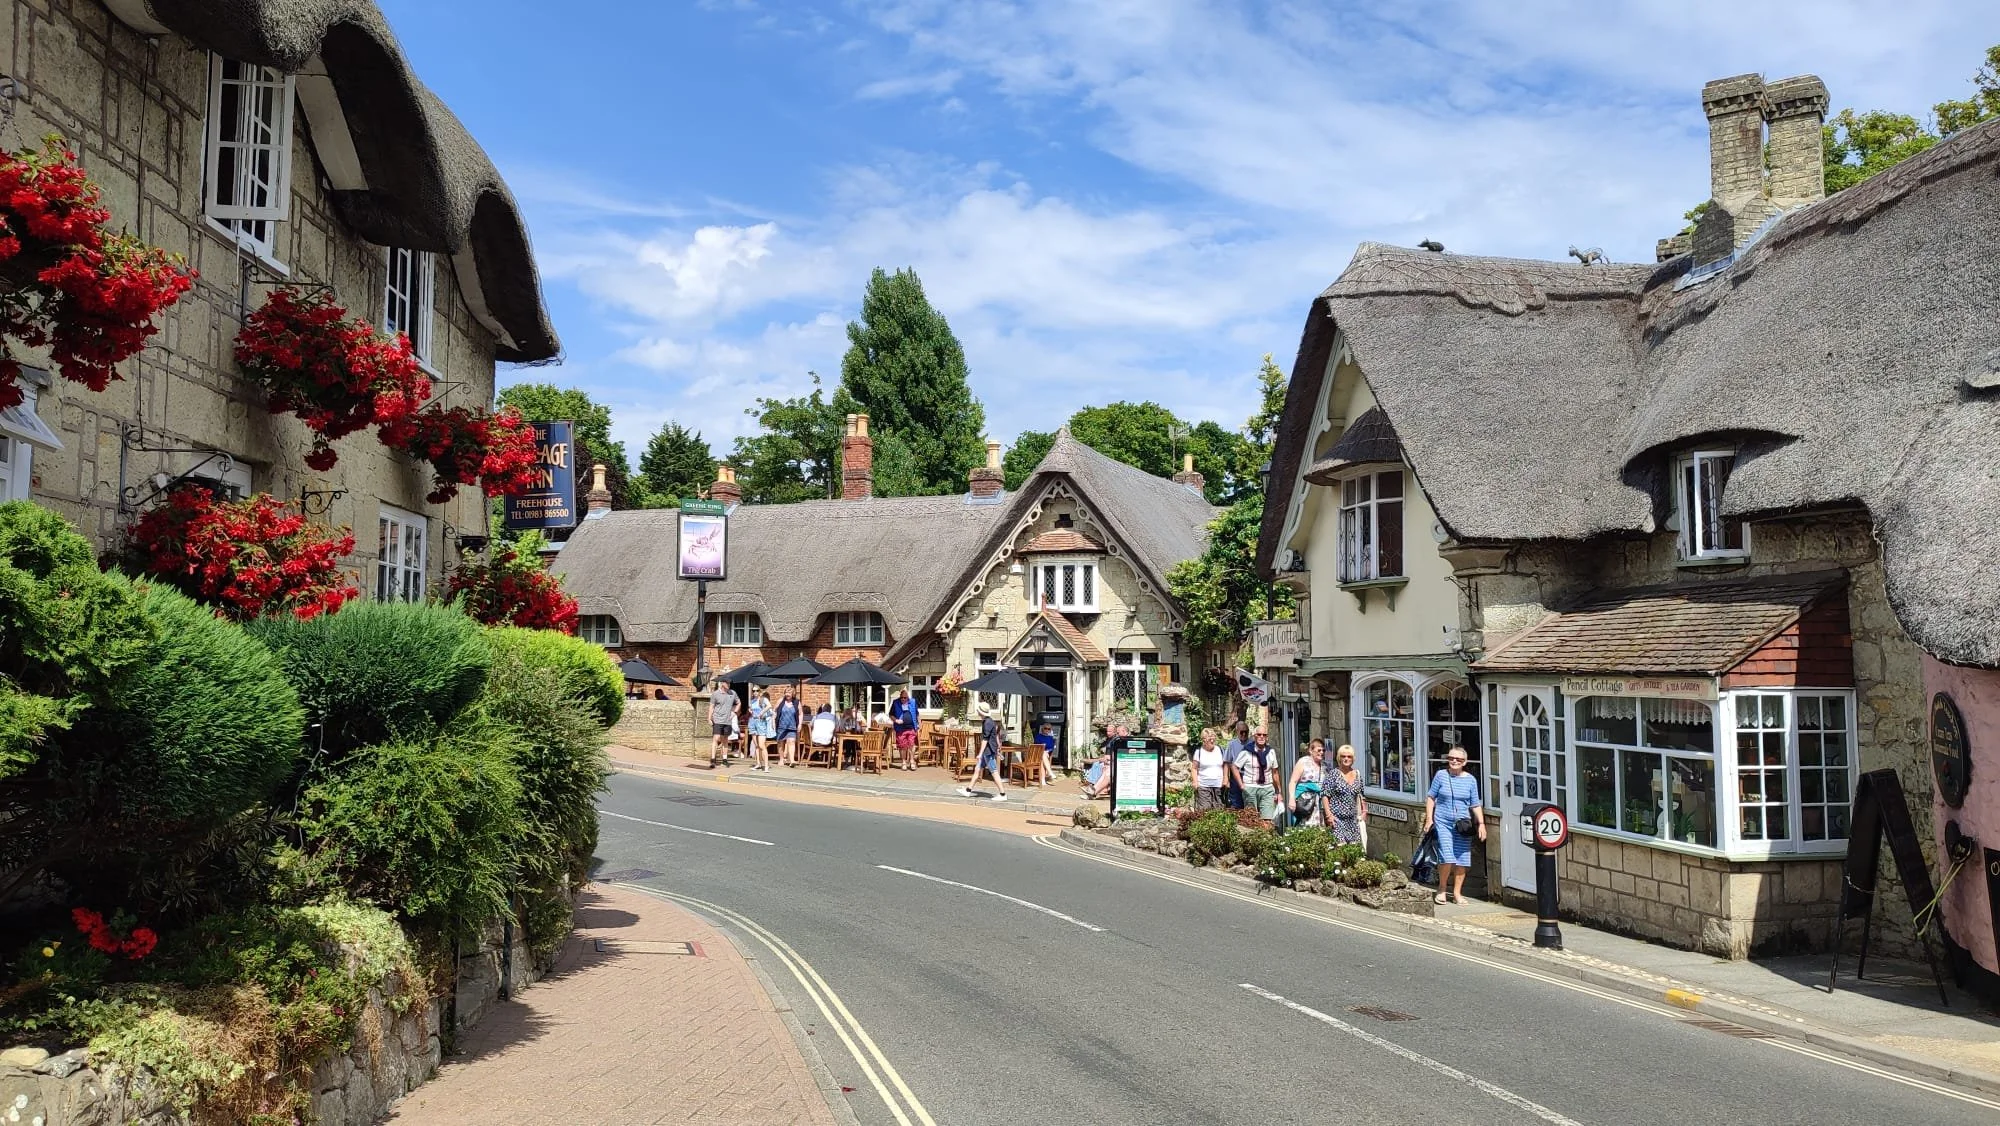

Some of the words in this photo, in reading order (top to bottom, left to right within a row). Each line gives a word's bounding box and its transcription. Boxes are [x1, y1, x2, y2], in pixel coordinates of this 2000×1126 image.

[535, 429, 547, 440] HE
[516, 497, 563, 508] FREEHOUSE
[544, 508, 569, 518] 865500
[1256, 625, 1275, 651] Pencil
[1276, 625, 1297, 644] Cotta
[1567, 678, 1588, 691] Pencil
[1591, 678, 1623, 694] Cottage
[1680, 682, 1700, 692] GARDEN
[1367, 803, 1388, 817] HURCH
[1389, 807, 1405, 820] ROAD
[1540, 818, 1561, 834] 20
